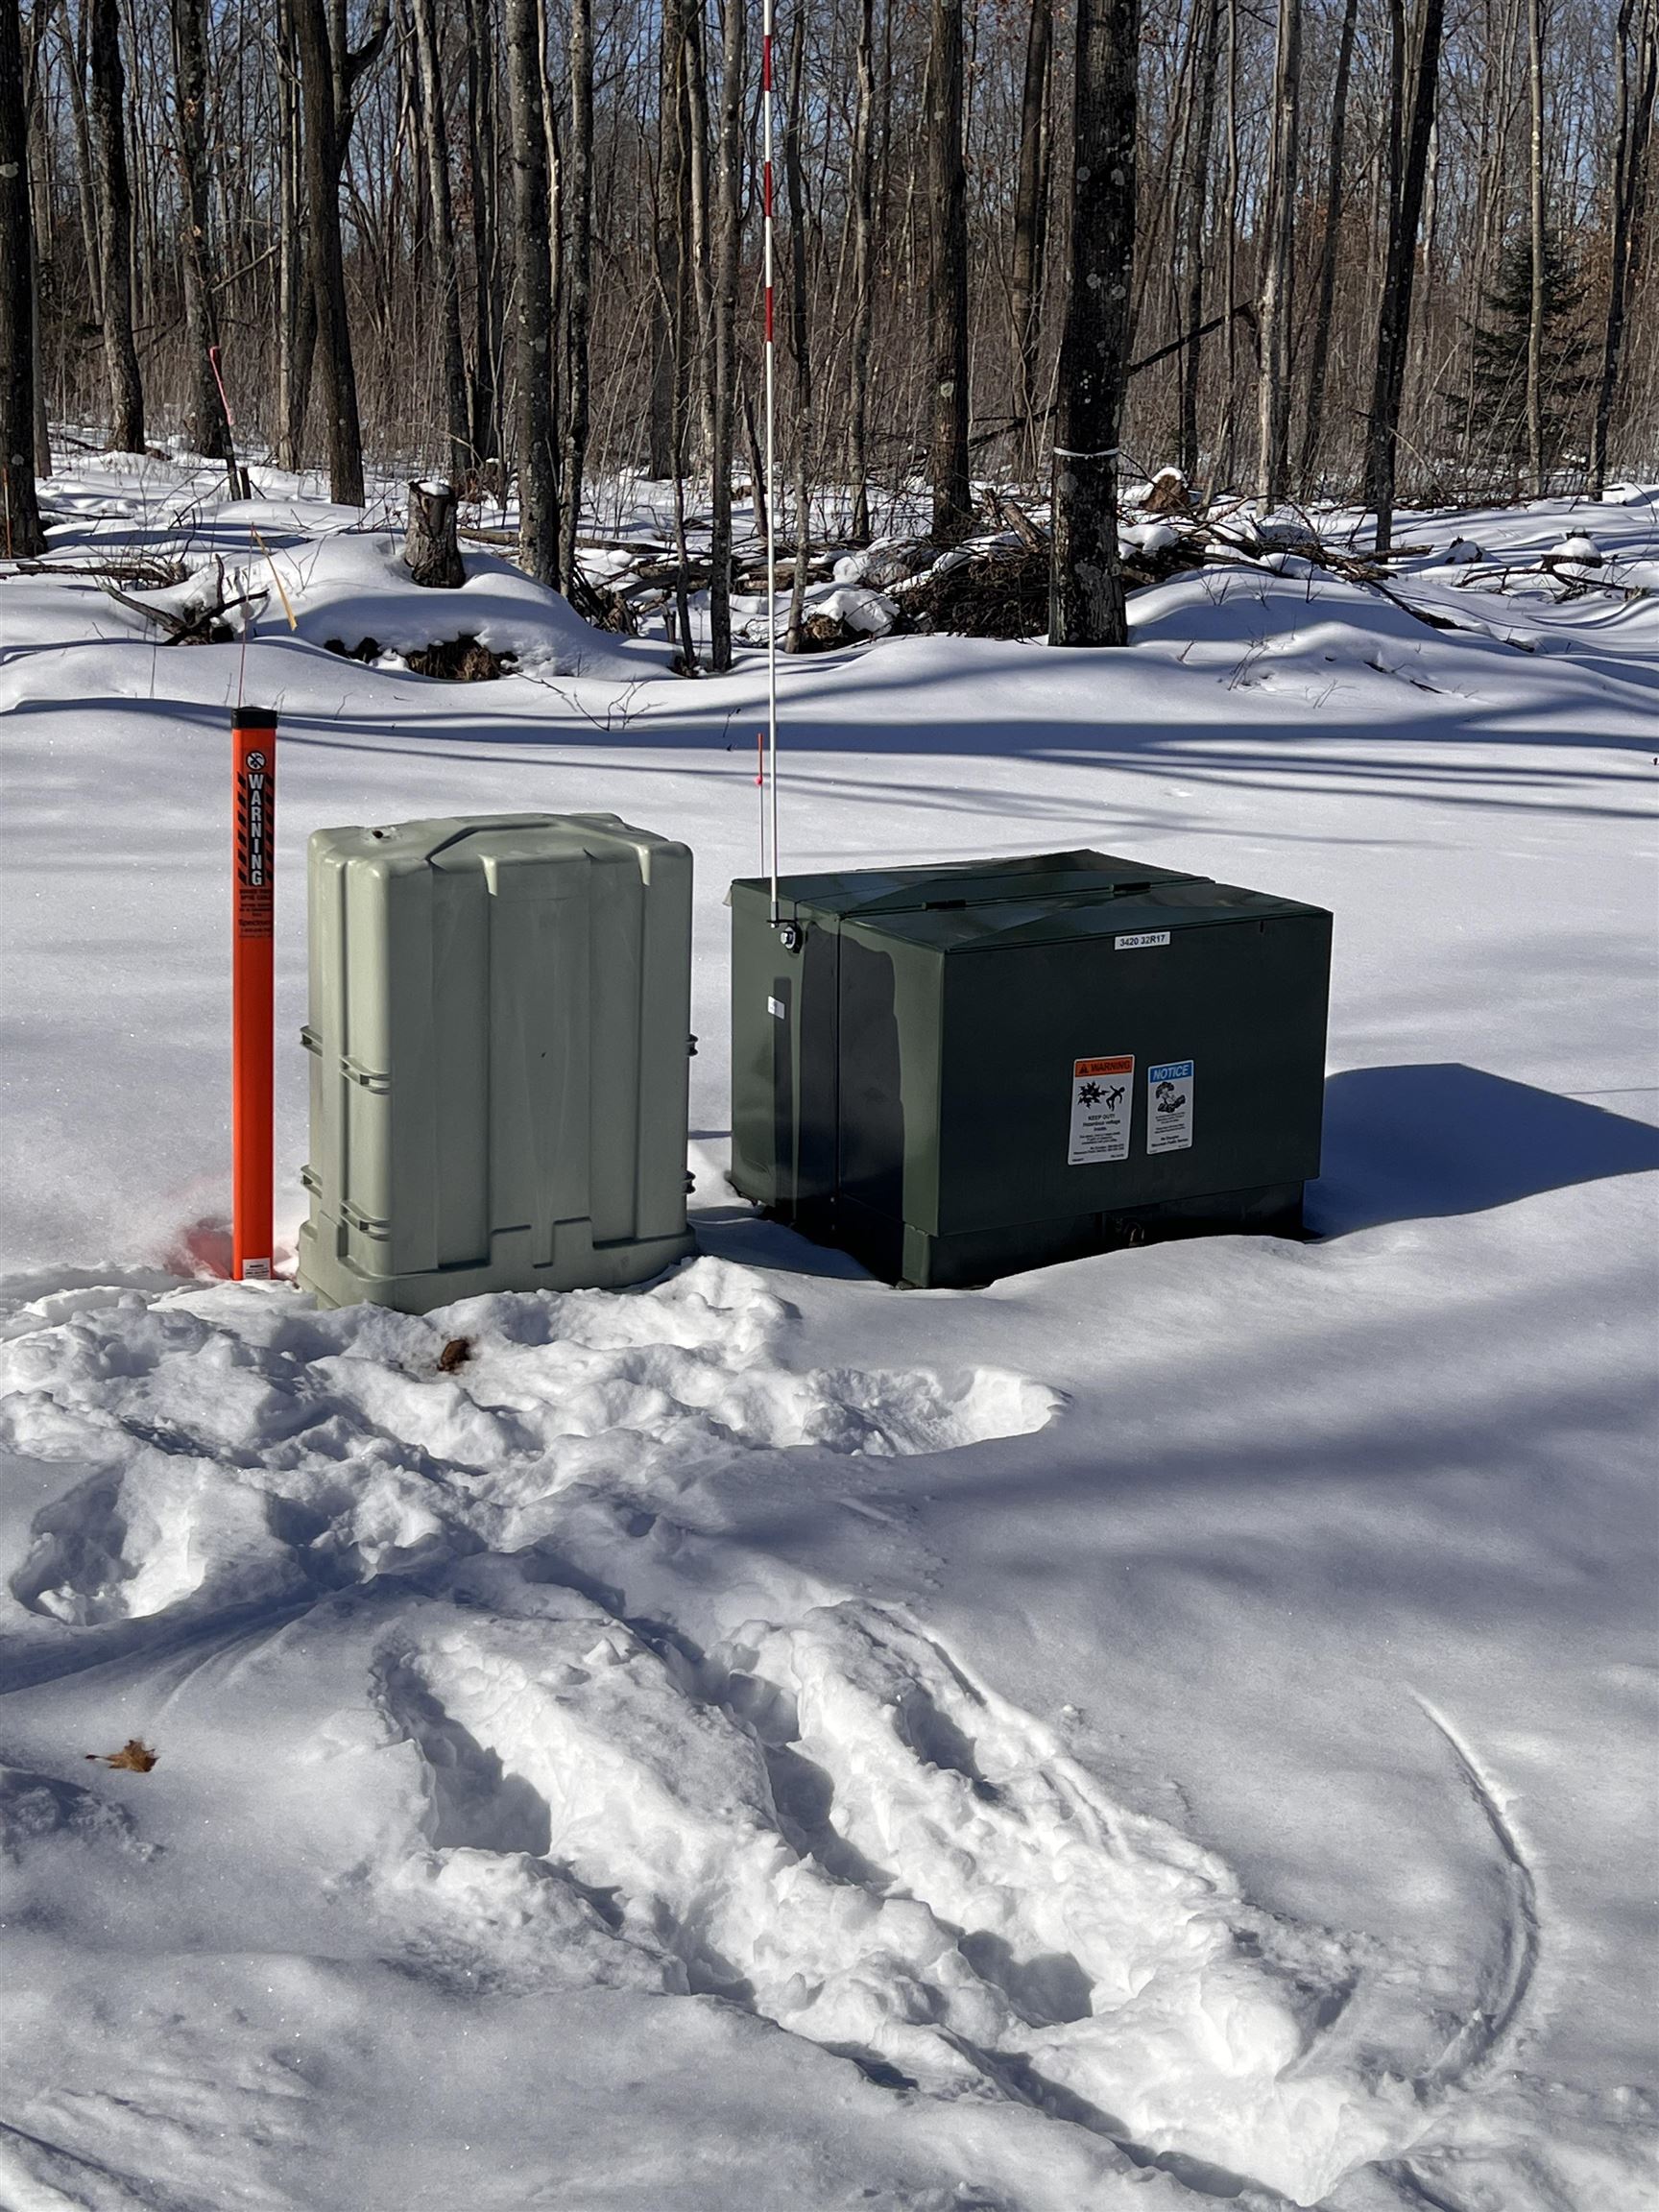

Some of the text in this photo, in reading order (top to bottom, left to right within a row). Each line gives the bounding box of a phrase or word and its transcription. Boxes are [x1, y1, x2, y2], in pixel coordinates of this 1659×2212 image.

[249, 774, 264, 885] WARNING
[1119, 937, 1139, 947] 3420
[1091, 1060, 1131, 1072] WARNING
[1153, 1065, 1190, 1081] NOTICE
